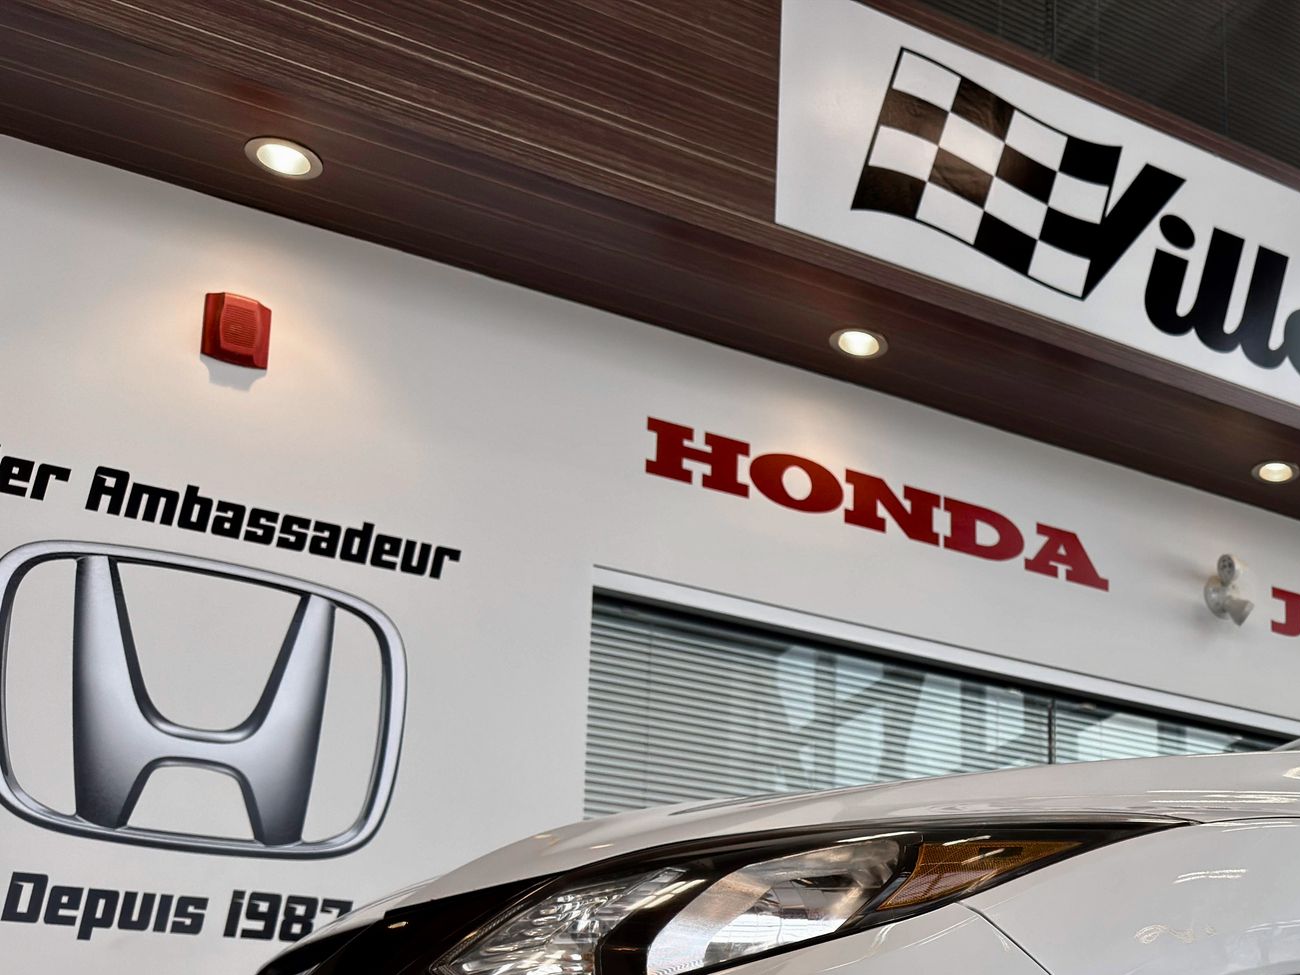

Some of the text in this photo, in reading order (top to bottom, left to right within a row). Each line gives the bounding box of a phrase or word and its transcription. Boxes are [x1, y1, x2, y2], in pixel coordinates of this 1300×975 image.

[0, 455, 462, 579] er Ambassadeur
[646, 417, 1109, 592] HONDA
[1, 871, 209, 941] Depuis
